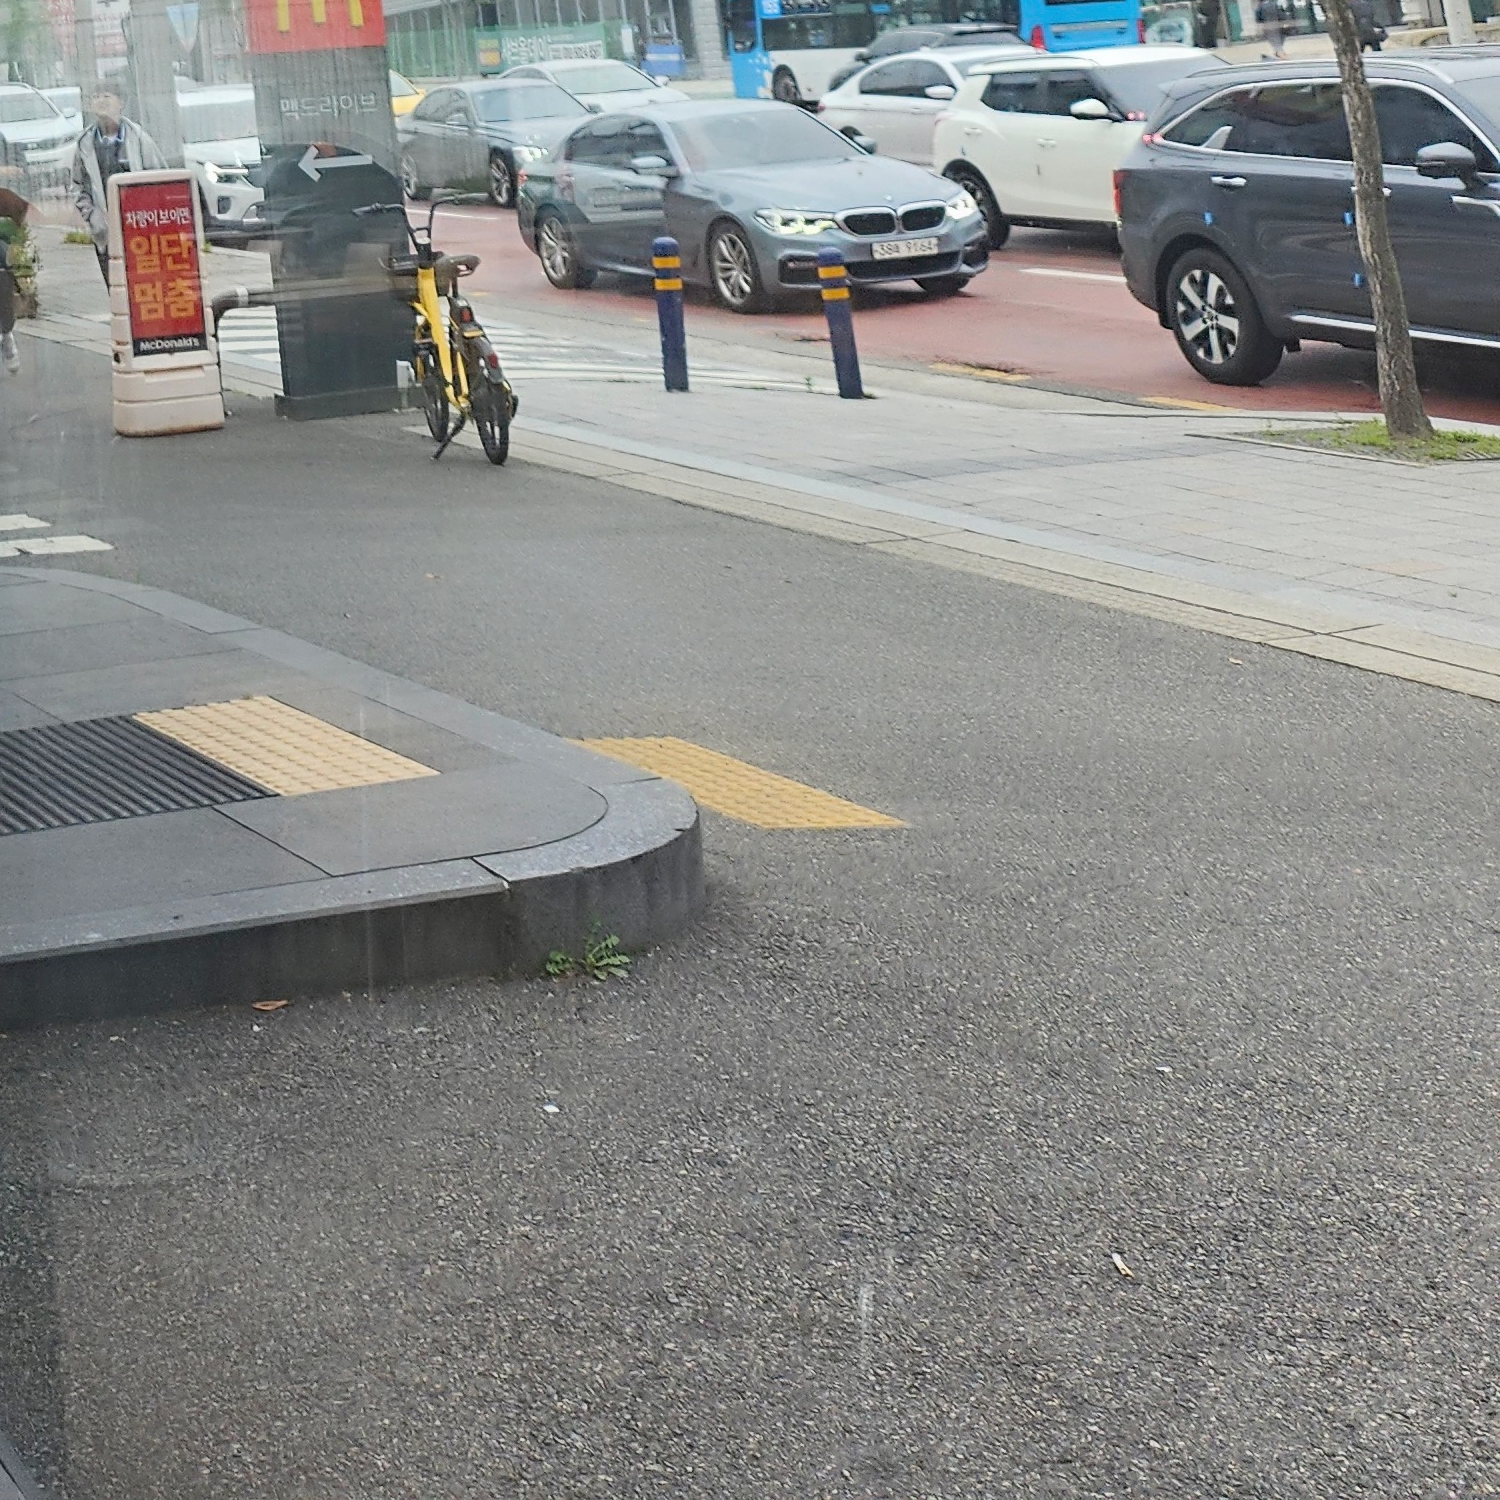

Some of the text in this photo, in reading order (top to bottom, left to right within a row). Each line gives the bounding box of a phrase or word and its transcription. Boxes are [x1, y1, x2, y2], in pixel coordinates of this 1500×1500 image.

[280, 92, 378, 120] 맥드라이브
[125, 206, 192, 228] 차량이 보이면
[129, 231, 193, 274] 일단
[133, 277, 199, 321] 멈춤
[139, 336, 200, 352] McDonald's
